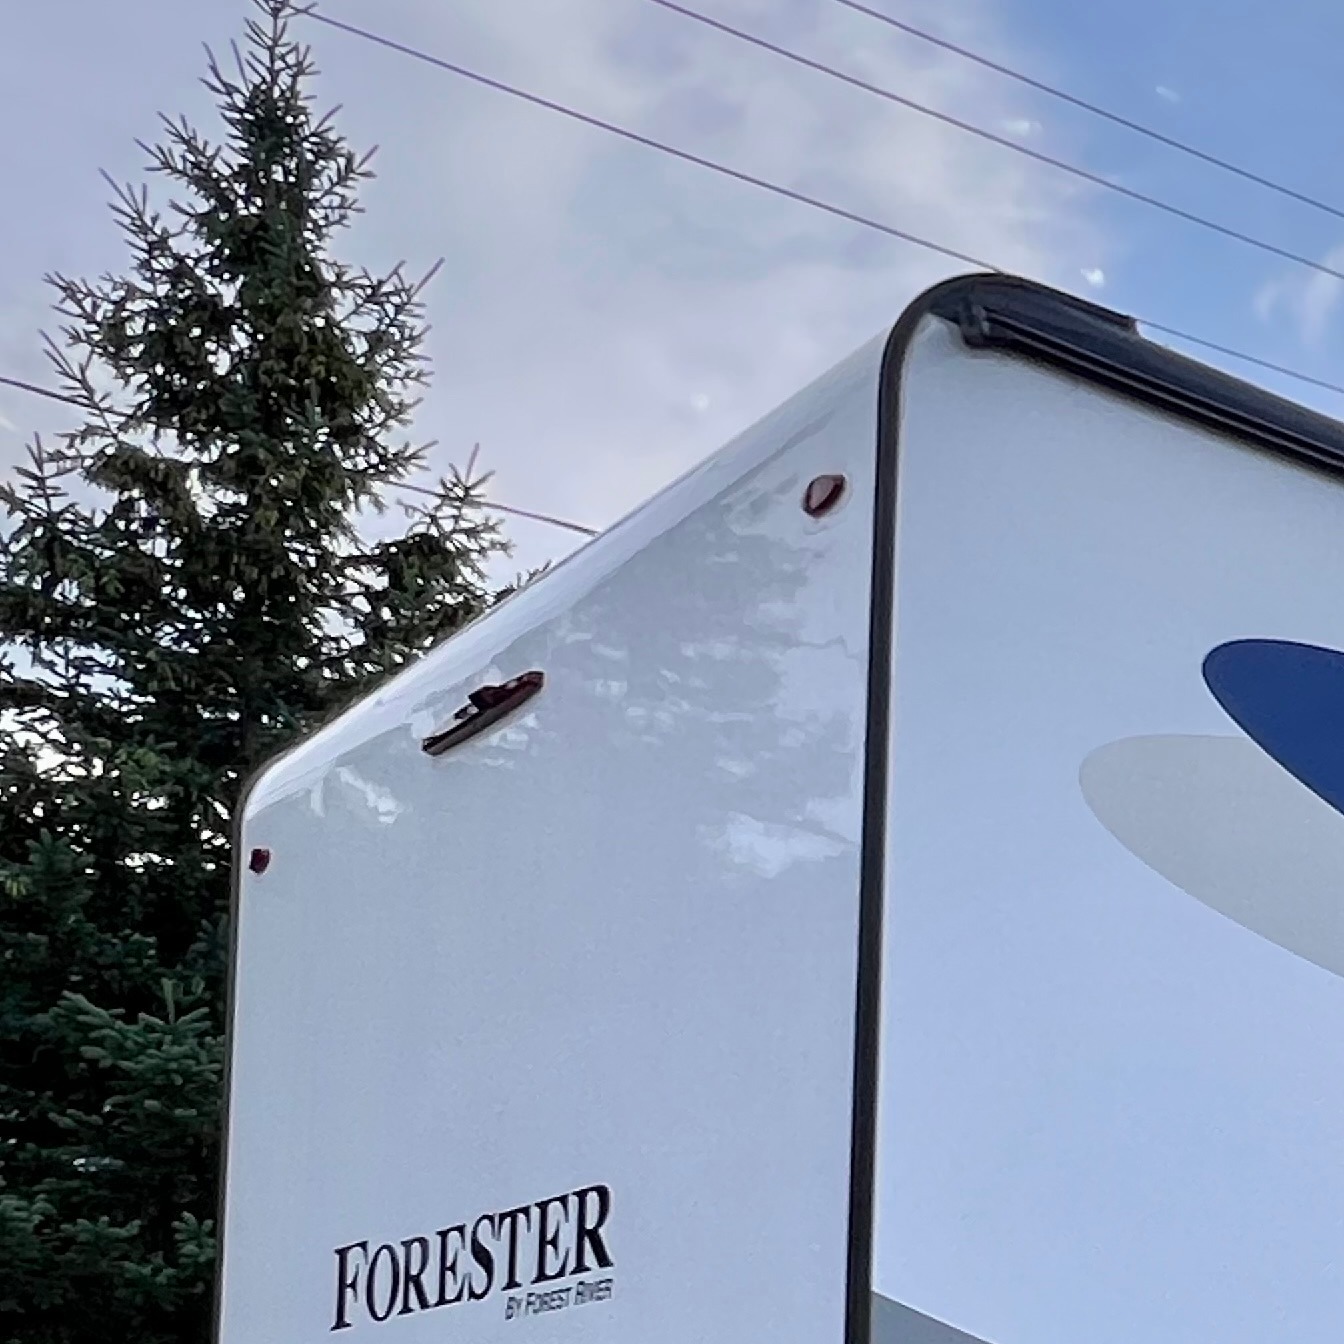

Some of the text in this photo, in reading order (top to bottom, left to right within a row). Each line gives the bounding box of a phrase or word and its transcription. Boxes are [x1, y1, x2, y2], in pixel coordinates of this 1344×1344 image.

[330, 1184, 613, 1332] FORESTER
[525, 1287, 572, 1315] FOREST
[574, 1279, 613, 1305] RIVER
